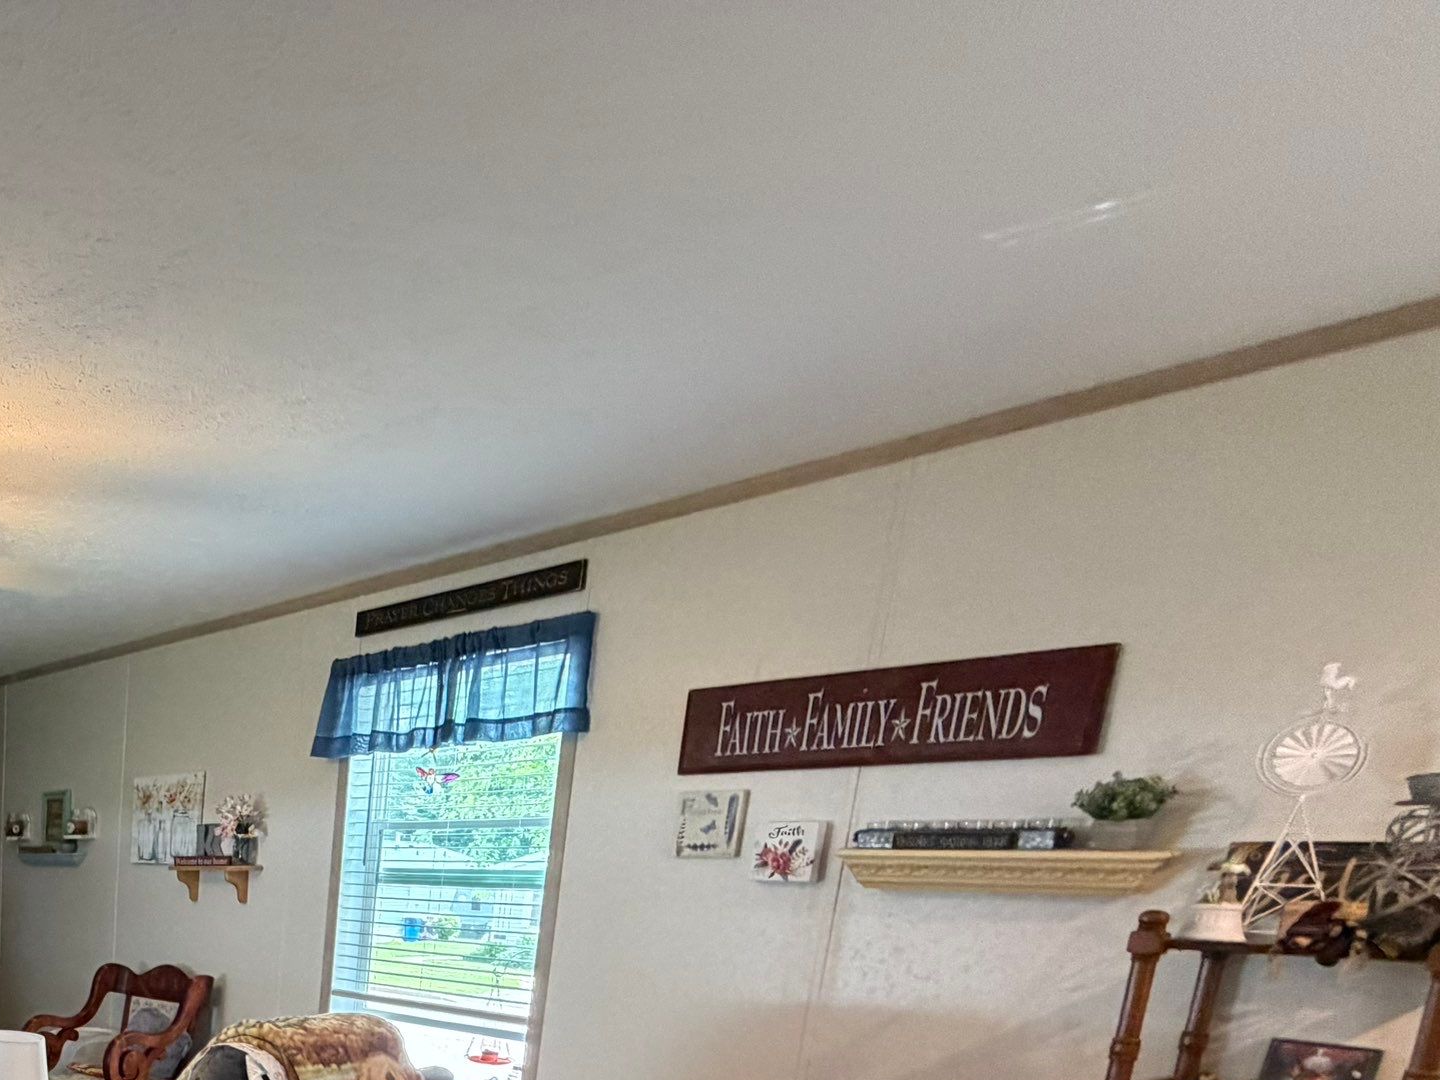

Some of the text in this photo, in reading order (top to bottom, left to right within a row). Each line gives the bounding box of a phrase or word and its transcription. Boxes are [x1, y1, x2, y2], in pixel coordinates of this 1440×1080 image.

[501, 570, 569, 600] THINGS
[714, 678, 1050, 757] FAITH FAMILY FRIENDS
